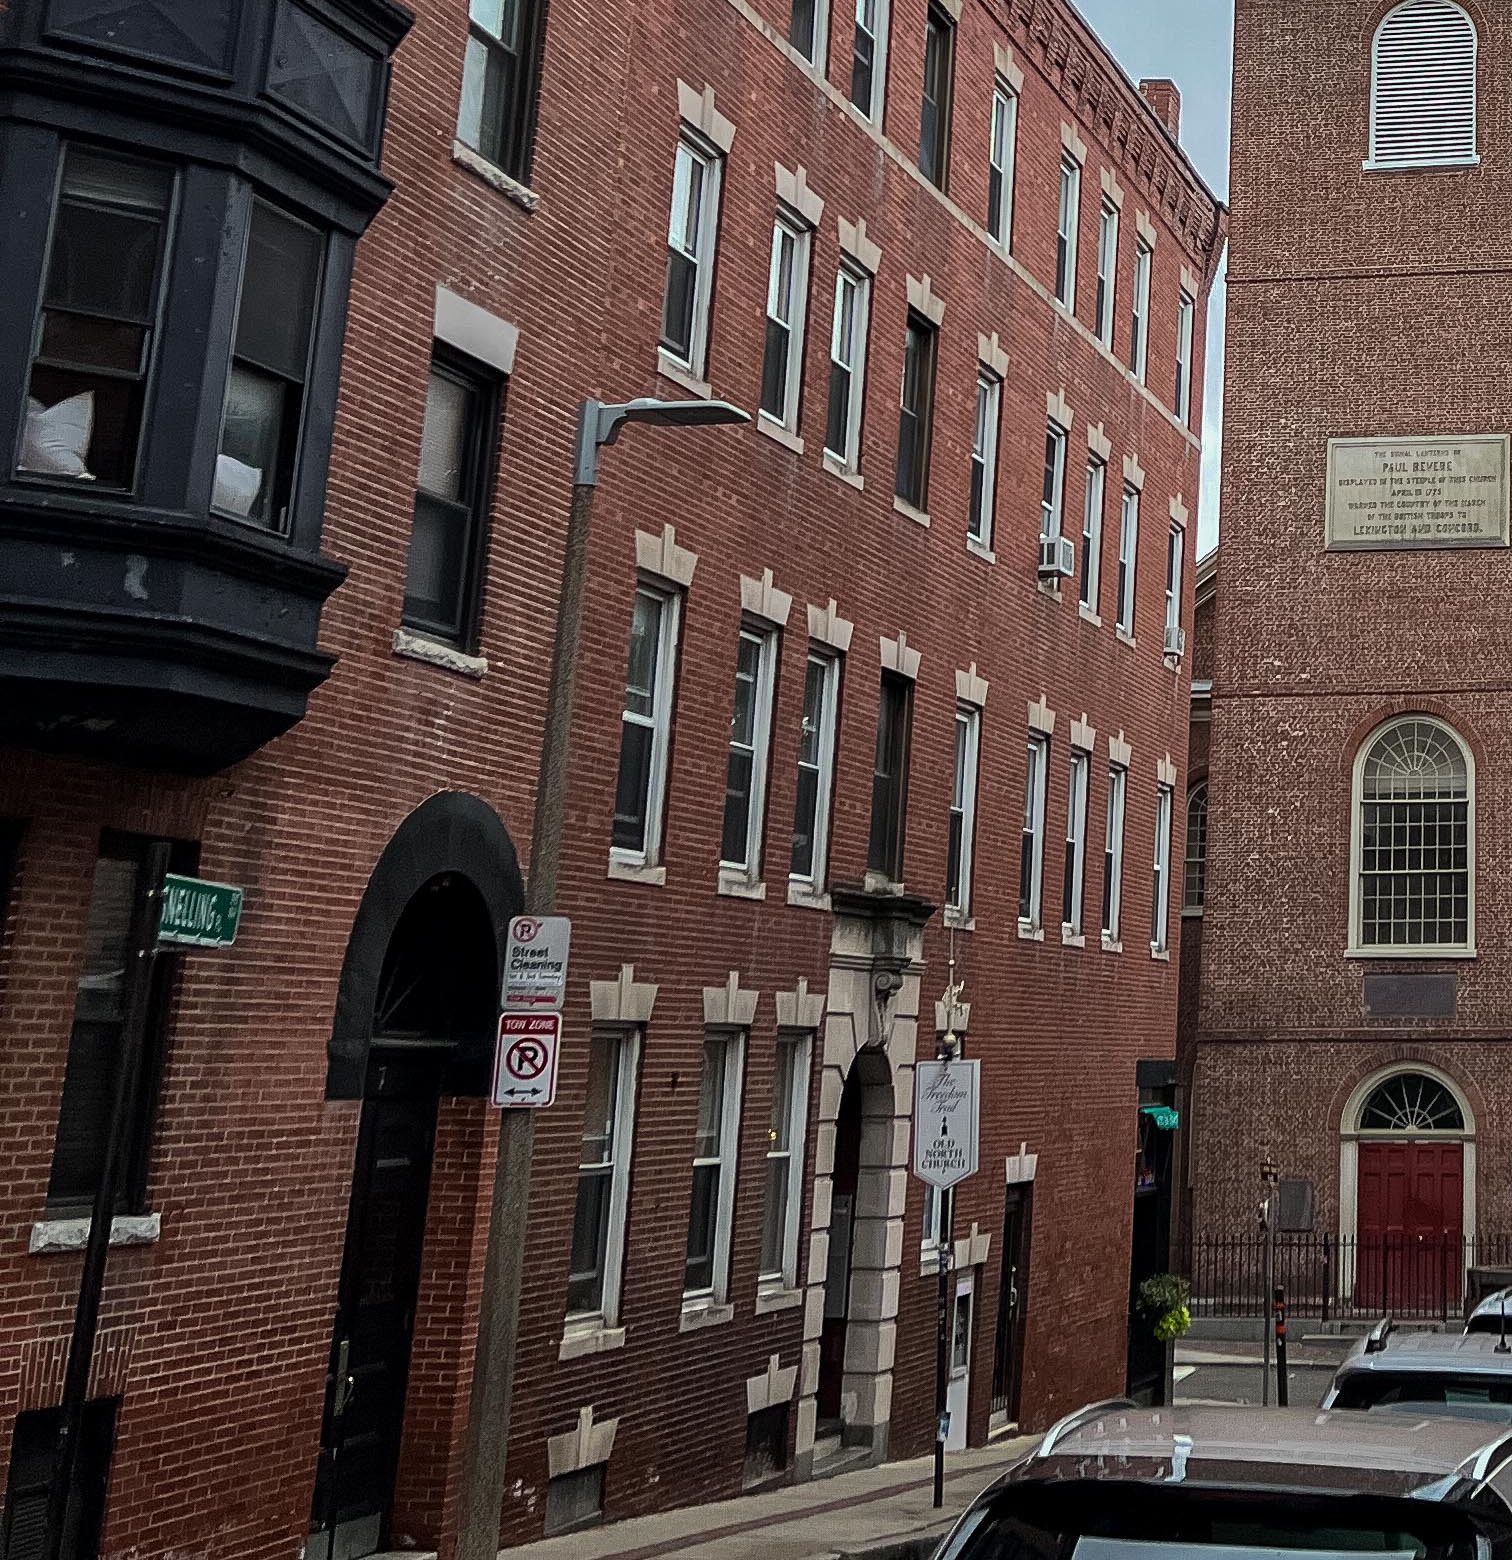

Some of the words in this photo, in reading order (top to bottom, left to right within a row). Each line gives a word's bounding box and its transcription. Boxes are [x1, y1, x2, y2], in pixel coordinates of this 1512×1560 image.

[1382, 462, 1408, 473] PAUL
[1412, 461, 1453, 472] REVERE
[1338, 478, 1378, 487] DISPLAYED
[1391, 489, 1413, 497] APRIL
[1353, 524, 1407, 536] LEXINGTON
[1411, 524, 1432, 535] AND
[512, 945, 549, 958] Street
[511, 958, 563, 973] Cleaning
[505, 1019, 528, 1030] TOW
[528, 1019, 556, 1030] ZONE
[931, 1073, 958, 1089] The
[921, 1085, 968, 1100] Freedom
[929, 1099, 960, 1114] Trail
[932, 1139, 956, 1149] OLD
[924, 1148, 963, 1159] NORTH
[921, 1159, 966, 1170] CHURCH
